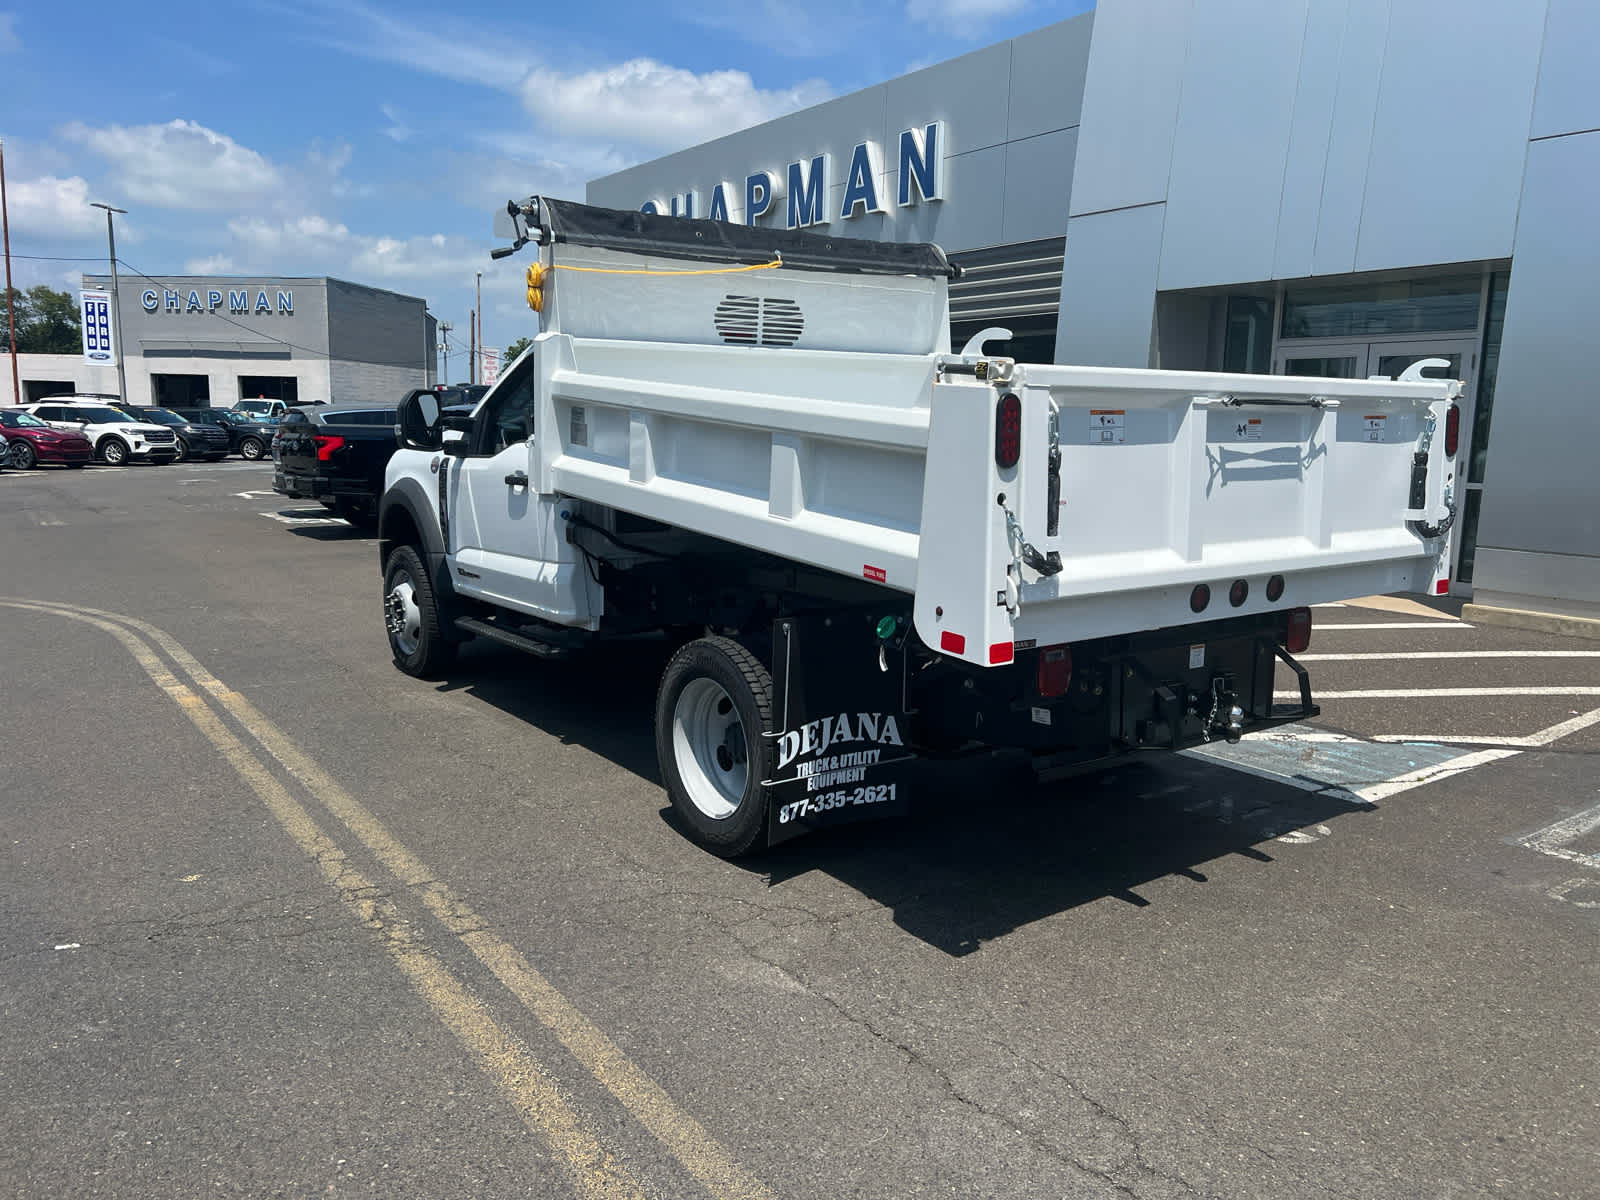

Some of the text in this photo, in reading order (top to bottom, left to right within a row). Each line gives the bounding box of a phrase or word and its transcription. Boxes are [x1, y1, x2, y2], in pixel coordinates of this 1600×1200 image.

[640, 120, 944, 231] APMAN
[141, 289, 294, 311] CHAPMAN
[87, 303, 96, 347] FORD
[100, 304, 109, 347] FORD
[777, 712, 904, 770] DEJANA
[807, 766, 867, 792] EQUIPMENT
[779, 783, 897, 824] 877-335-2621
